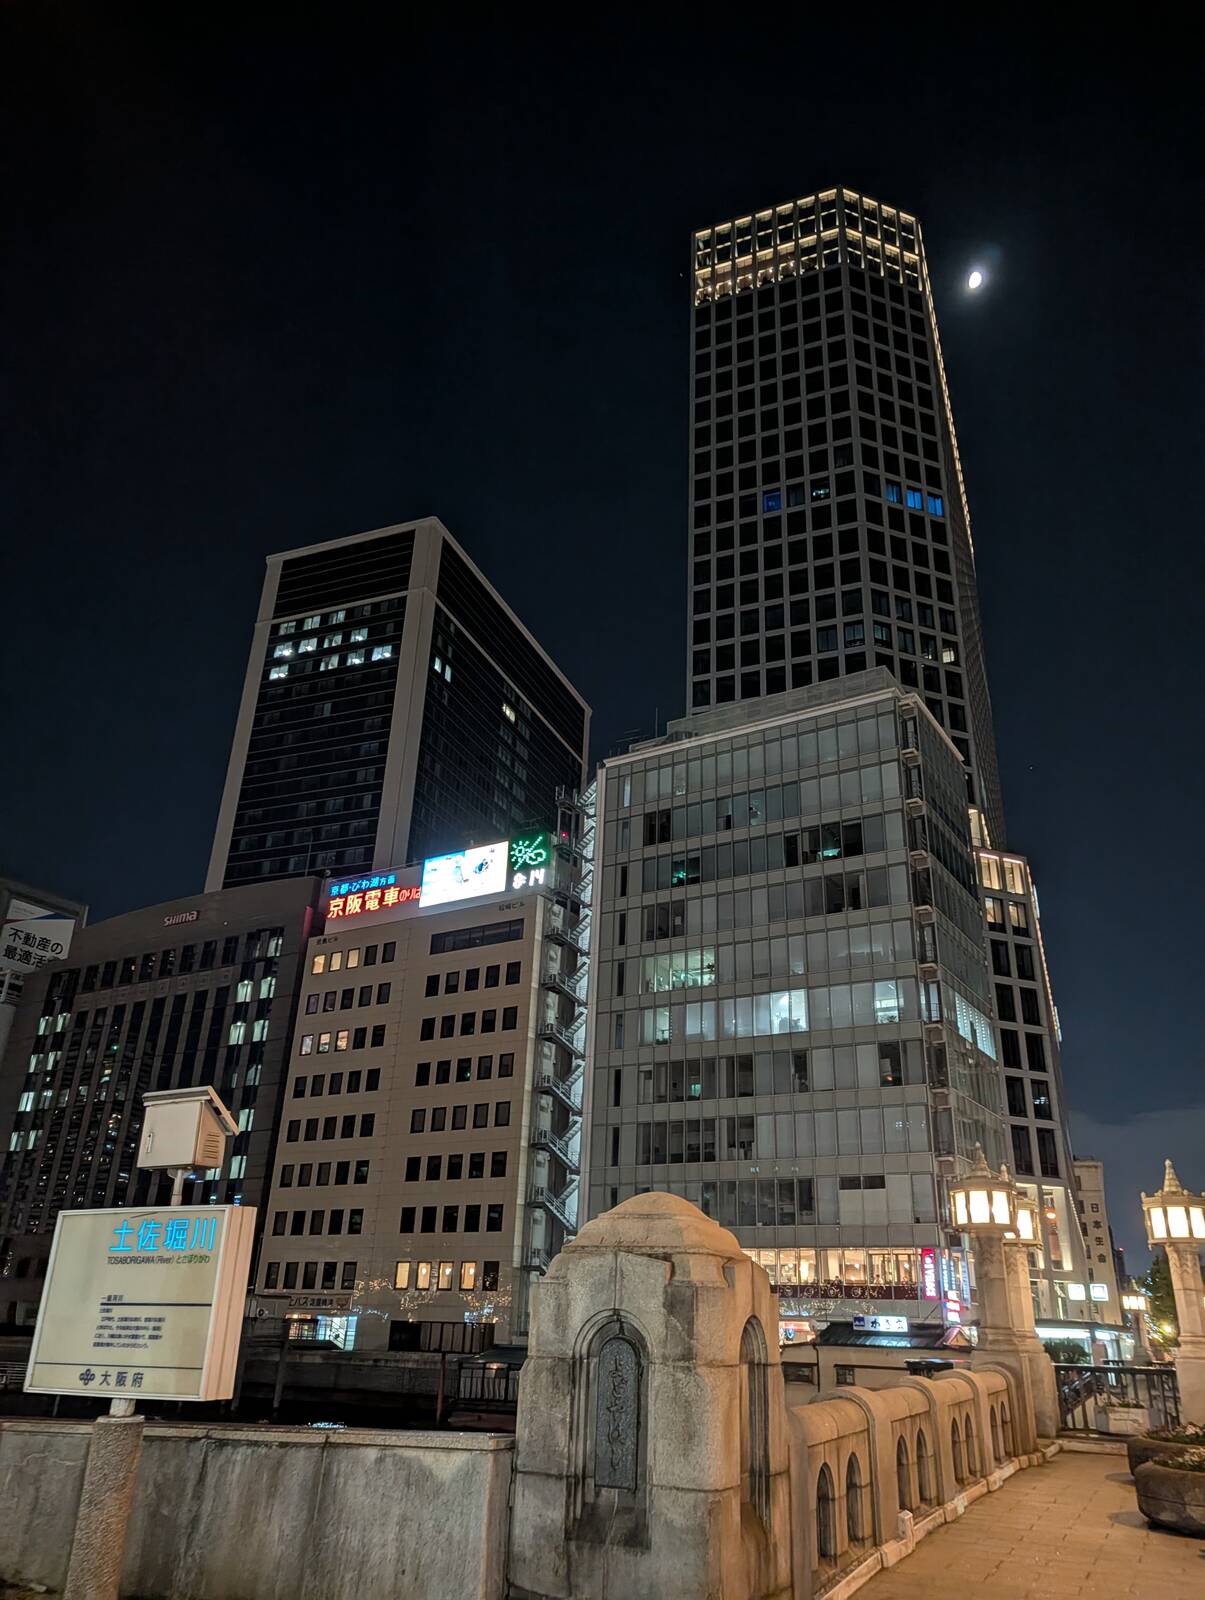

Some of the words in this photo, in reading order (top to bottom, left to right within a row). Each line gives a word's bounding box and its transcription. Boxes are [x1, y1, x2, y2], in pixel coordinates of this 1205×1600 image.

[8, 927, 63, 955] 不動産の
[108, 1216, 217, 1252] 土佐堀川
[98, 1371, 145, 1388] 大阪府
